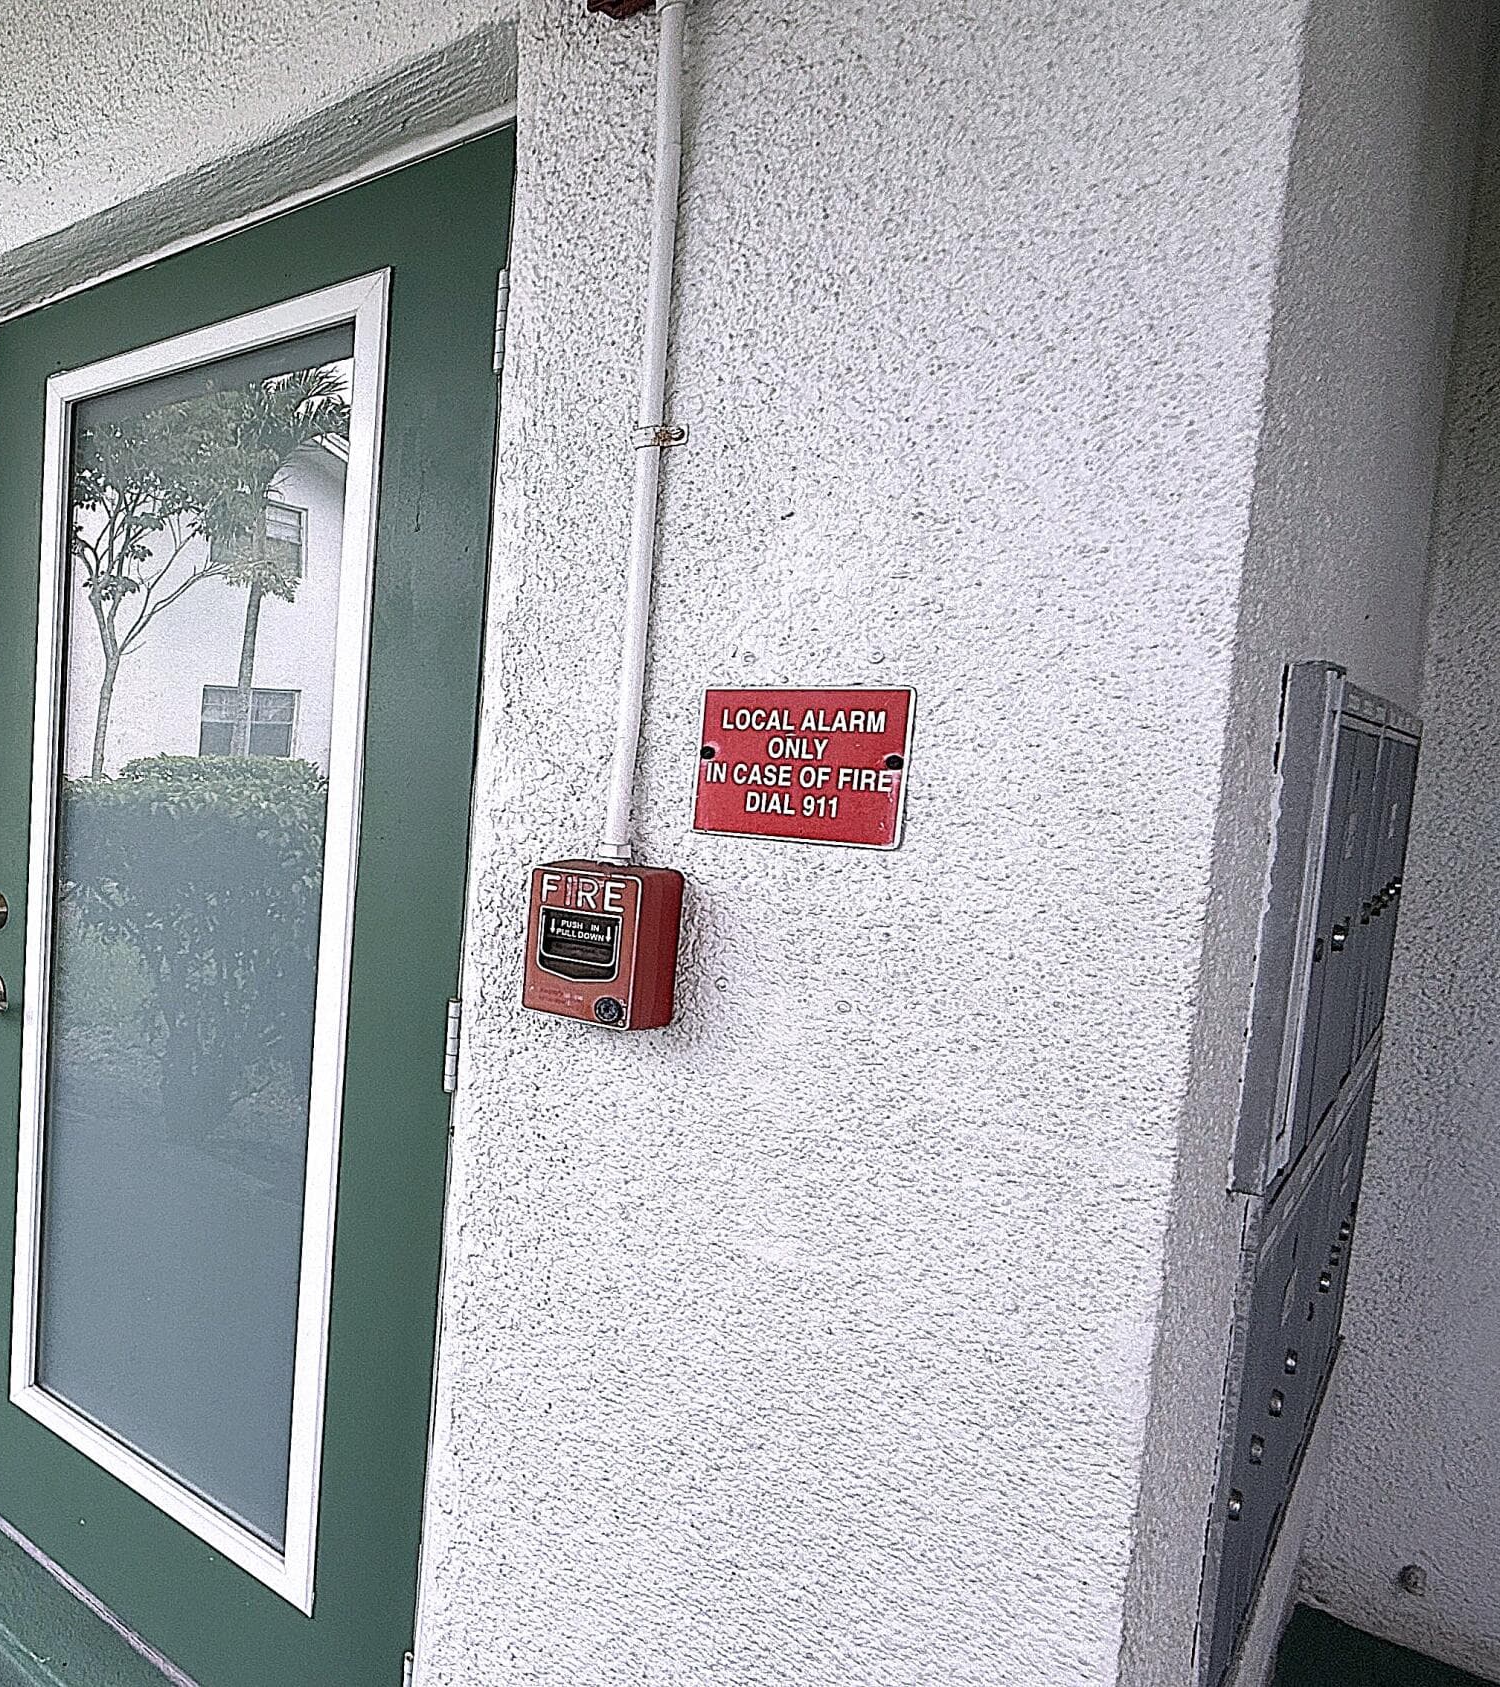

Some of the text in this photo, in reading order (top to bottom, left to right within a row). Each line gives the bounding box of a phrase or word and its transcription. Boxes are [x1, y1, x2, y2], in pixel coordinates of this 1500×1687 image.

[722, 709, 886, 732] LOCAL ALARM
[768, 737, 828, 760] ONLY
[706, 762, 893, 792] IN CASE OF FIRE
[745, 792, 839, 818] DIAL 911
[541, 873, 627, 913] FIRE
[556, 928, 605, 942] PULL DOWN
[561, 919, 600, 932] PUSH IN
